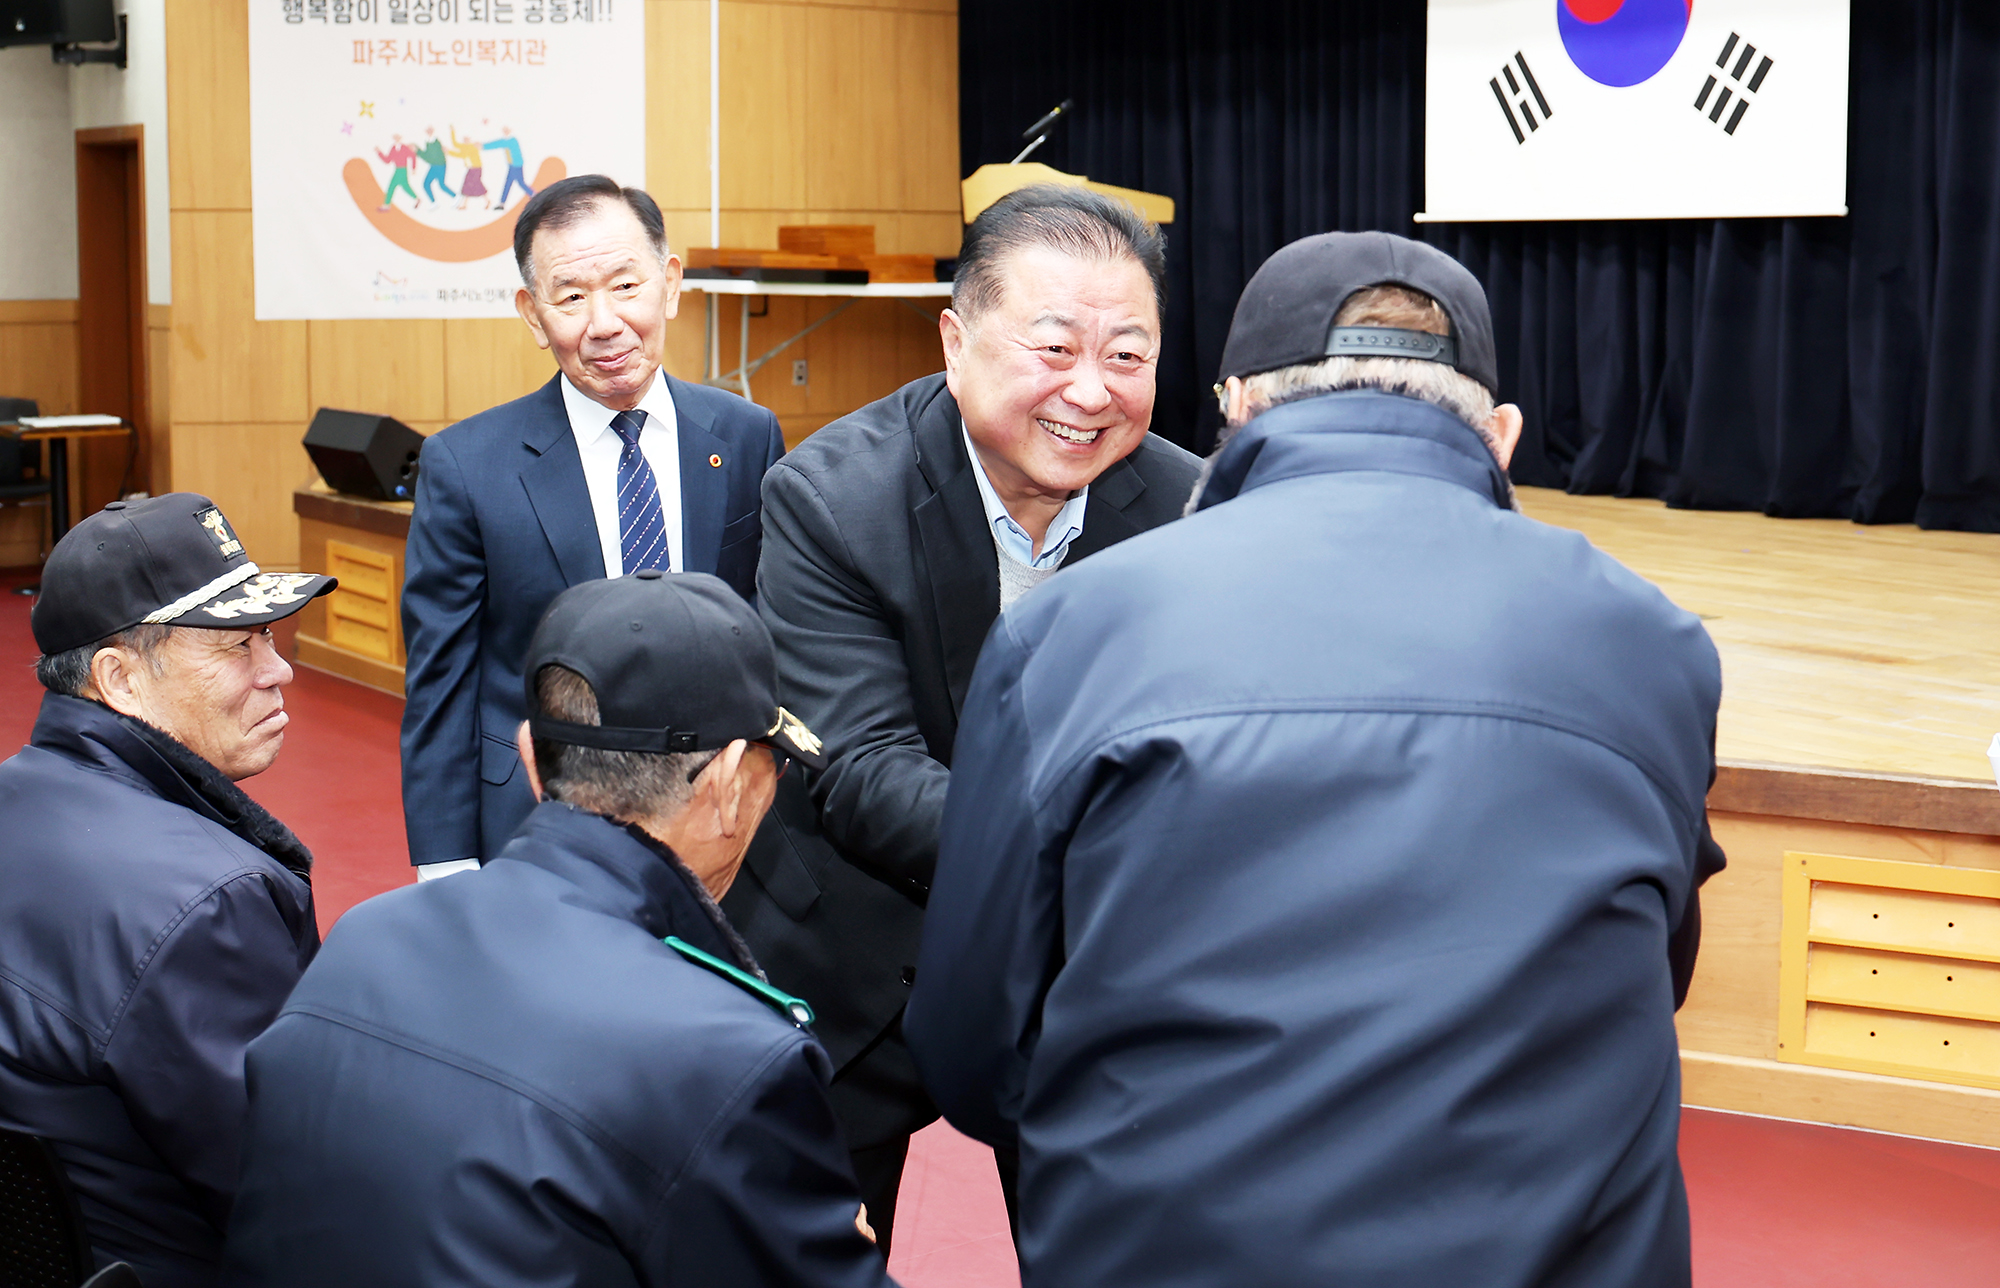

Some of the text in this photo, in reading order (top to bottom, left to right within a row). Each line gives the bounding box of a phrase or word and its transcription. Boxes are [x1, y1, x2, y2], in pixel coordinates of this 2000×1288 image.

[388, 0, 458, 24] 일상이
[468, 0, 513, 23] 되는
[352, 39, 547, 66] 파주시노인복지관
